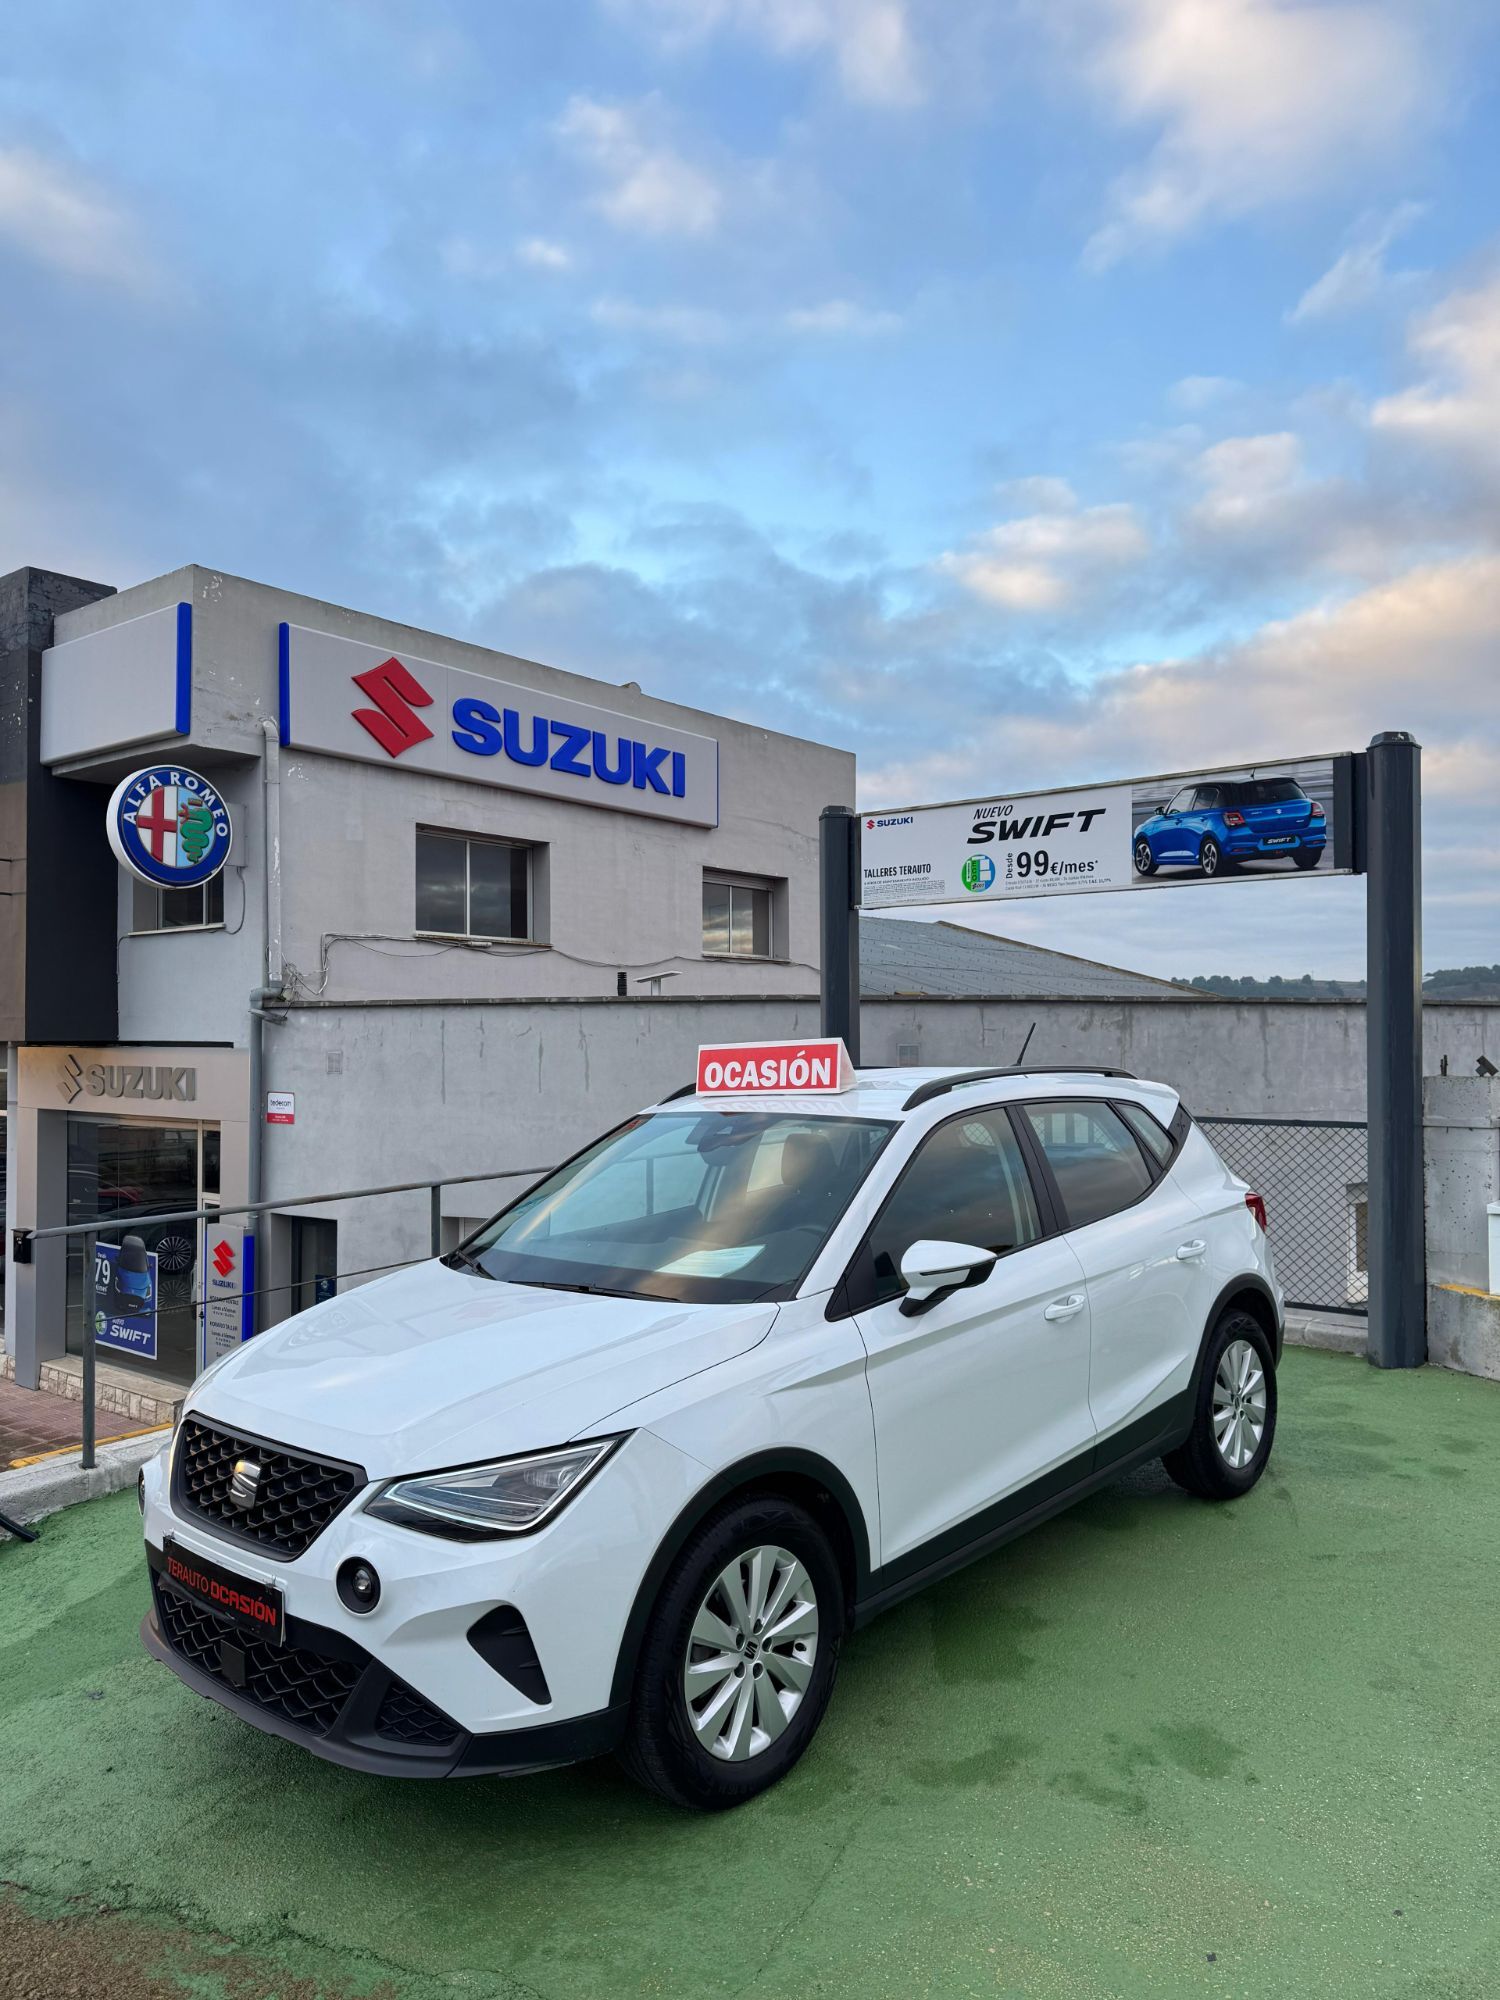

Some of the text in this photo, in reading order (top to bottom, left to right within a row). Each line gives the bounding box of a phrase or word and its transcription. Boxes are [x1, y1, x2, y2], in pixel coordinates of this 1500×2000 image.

[452, 698, 686, 798] SUZUKI
[123, 771, 228, 837] ALFA ROMEO
[973, 804, 1013, 820] NUEVO
[877, 816, 914, 827] SUZUKI
[967, 808, 1106, 844] SWIFT
[1267, 836, 1292, 844] SWIFT
[864, 863, 931, 878] TALLERES TERAUTO
[1005, 852, 1013, 879] Desde
[85, 1064, 197, 1101] SUZUKI
[704, 1050, 831, 1088] OCASIÓN
[212, 1279, 234, 1289] SUZUKI
[110, 1324, 151, 1345] SWIFT
[167, 1556, 276, 1627] TERAUTO OCASIÓN
